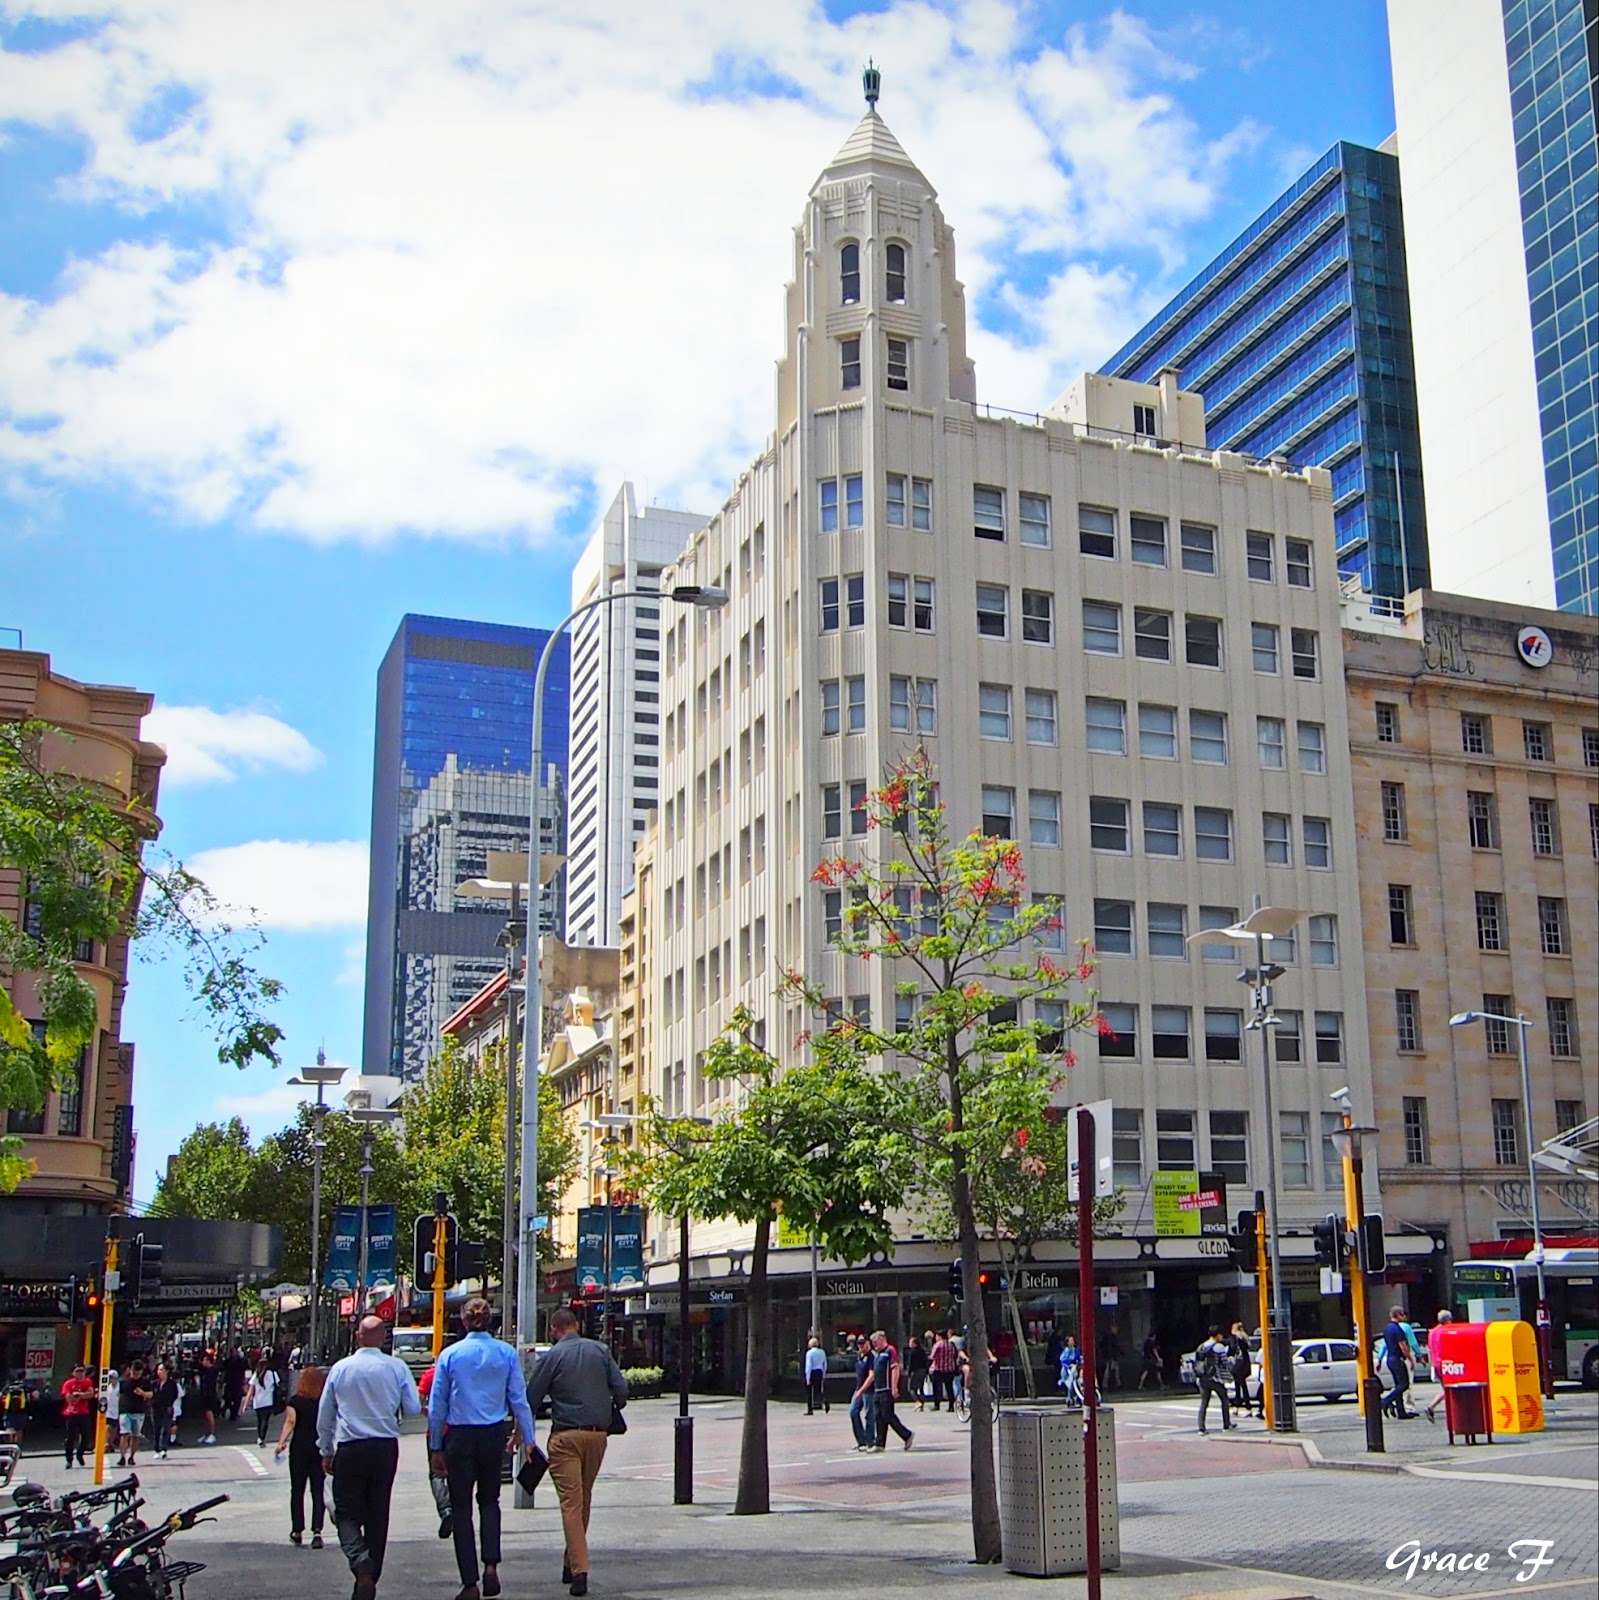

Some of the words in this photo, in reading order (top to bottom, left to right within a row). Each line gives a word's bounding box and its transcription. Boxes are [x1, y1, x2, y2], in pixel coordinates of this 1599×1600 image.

[1178, 1195, 1191, 1203] ONE
[1193, 1191, 1215, 1200] FLOOR
[1180, 1199, 1218, 1210] REMAINING
[1203, 1222, 1226, 1232] axia
[1025, 1273, 1058, 1287] Stefan
[164, 1286, 233, 1297] LORSHEIM
[826, 1279, 864, 1294] Stefan
[709, 1290, 734, 1301] Stefan
[1441, 1363, 1465, 1375] POST
